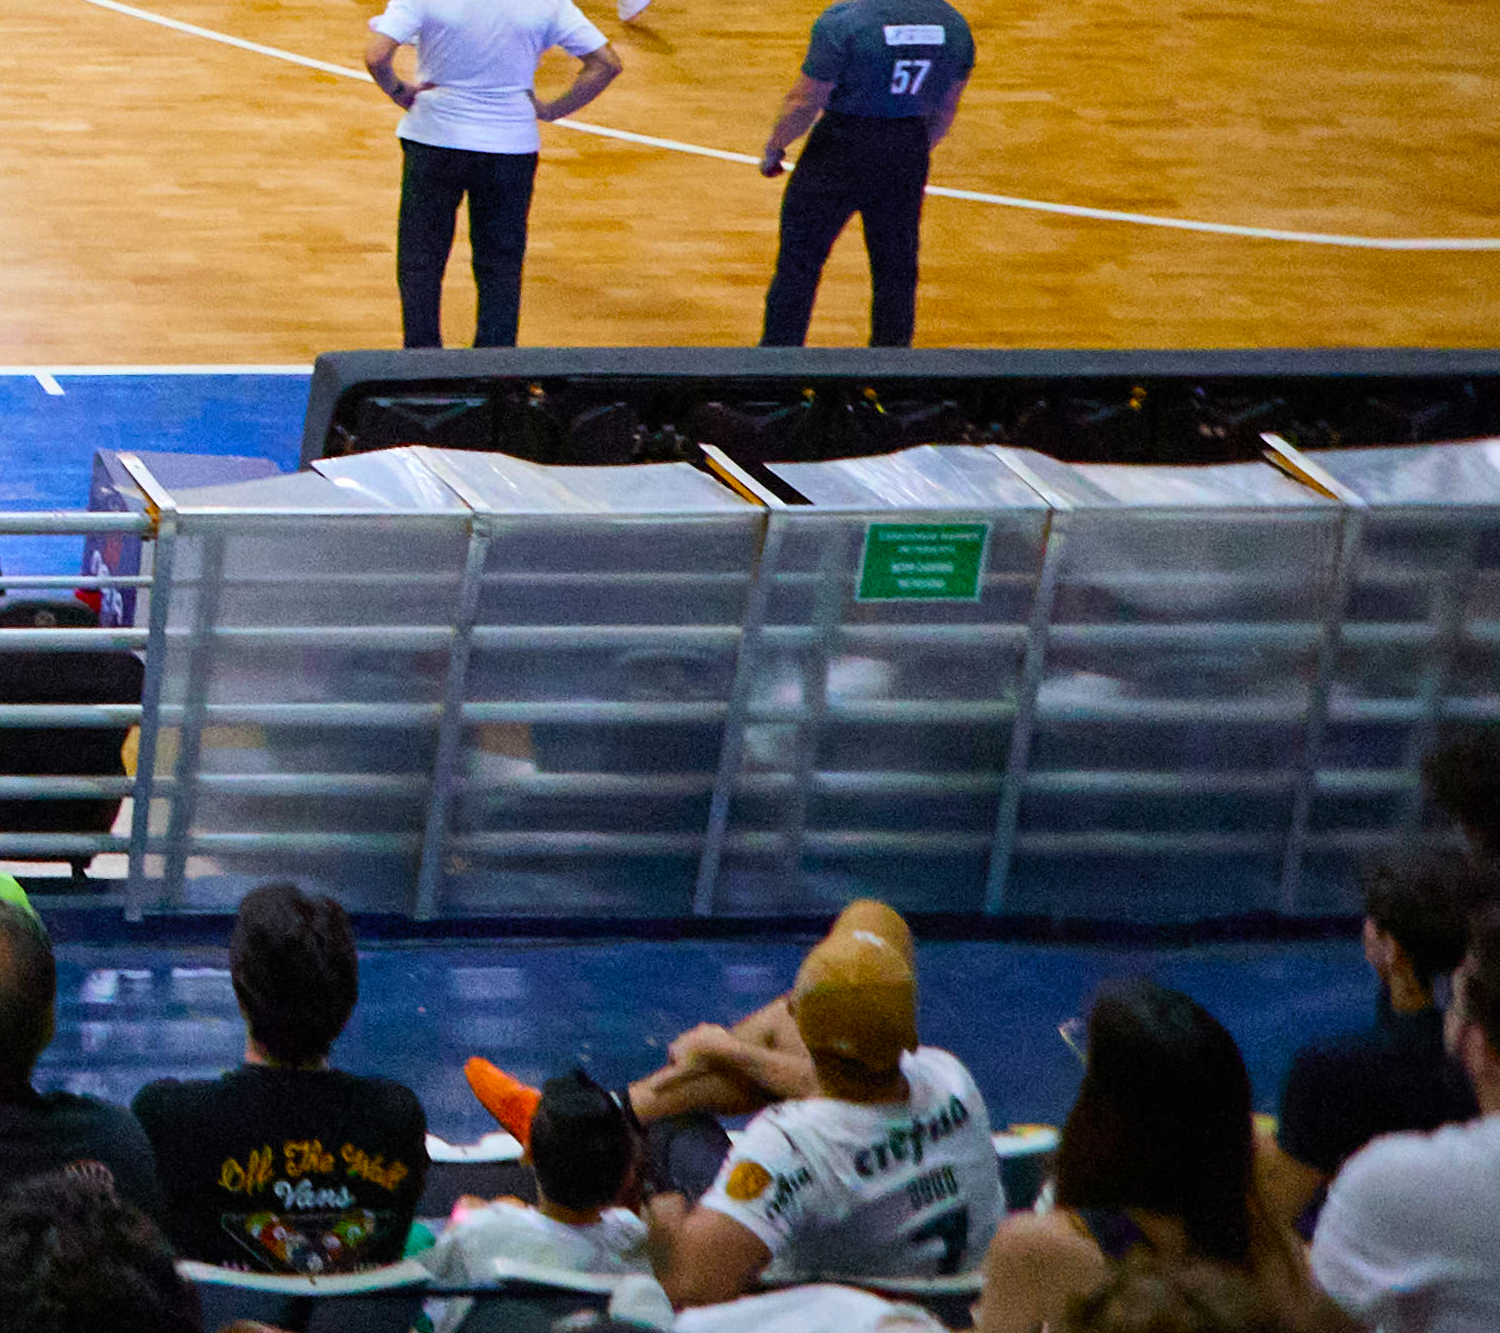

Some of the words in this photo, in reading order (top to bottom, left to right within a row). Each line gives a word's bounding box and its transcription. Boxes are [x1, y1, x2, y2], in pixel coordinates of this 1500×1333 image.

[891, 60, 931, 95] 57
[217, 1144, 275, 1196] Off
[283, 1138, 336, 1177] The
[340, 1141, 409, 1192] Wall
[274, 1178, 356, 1211] Vans
